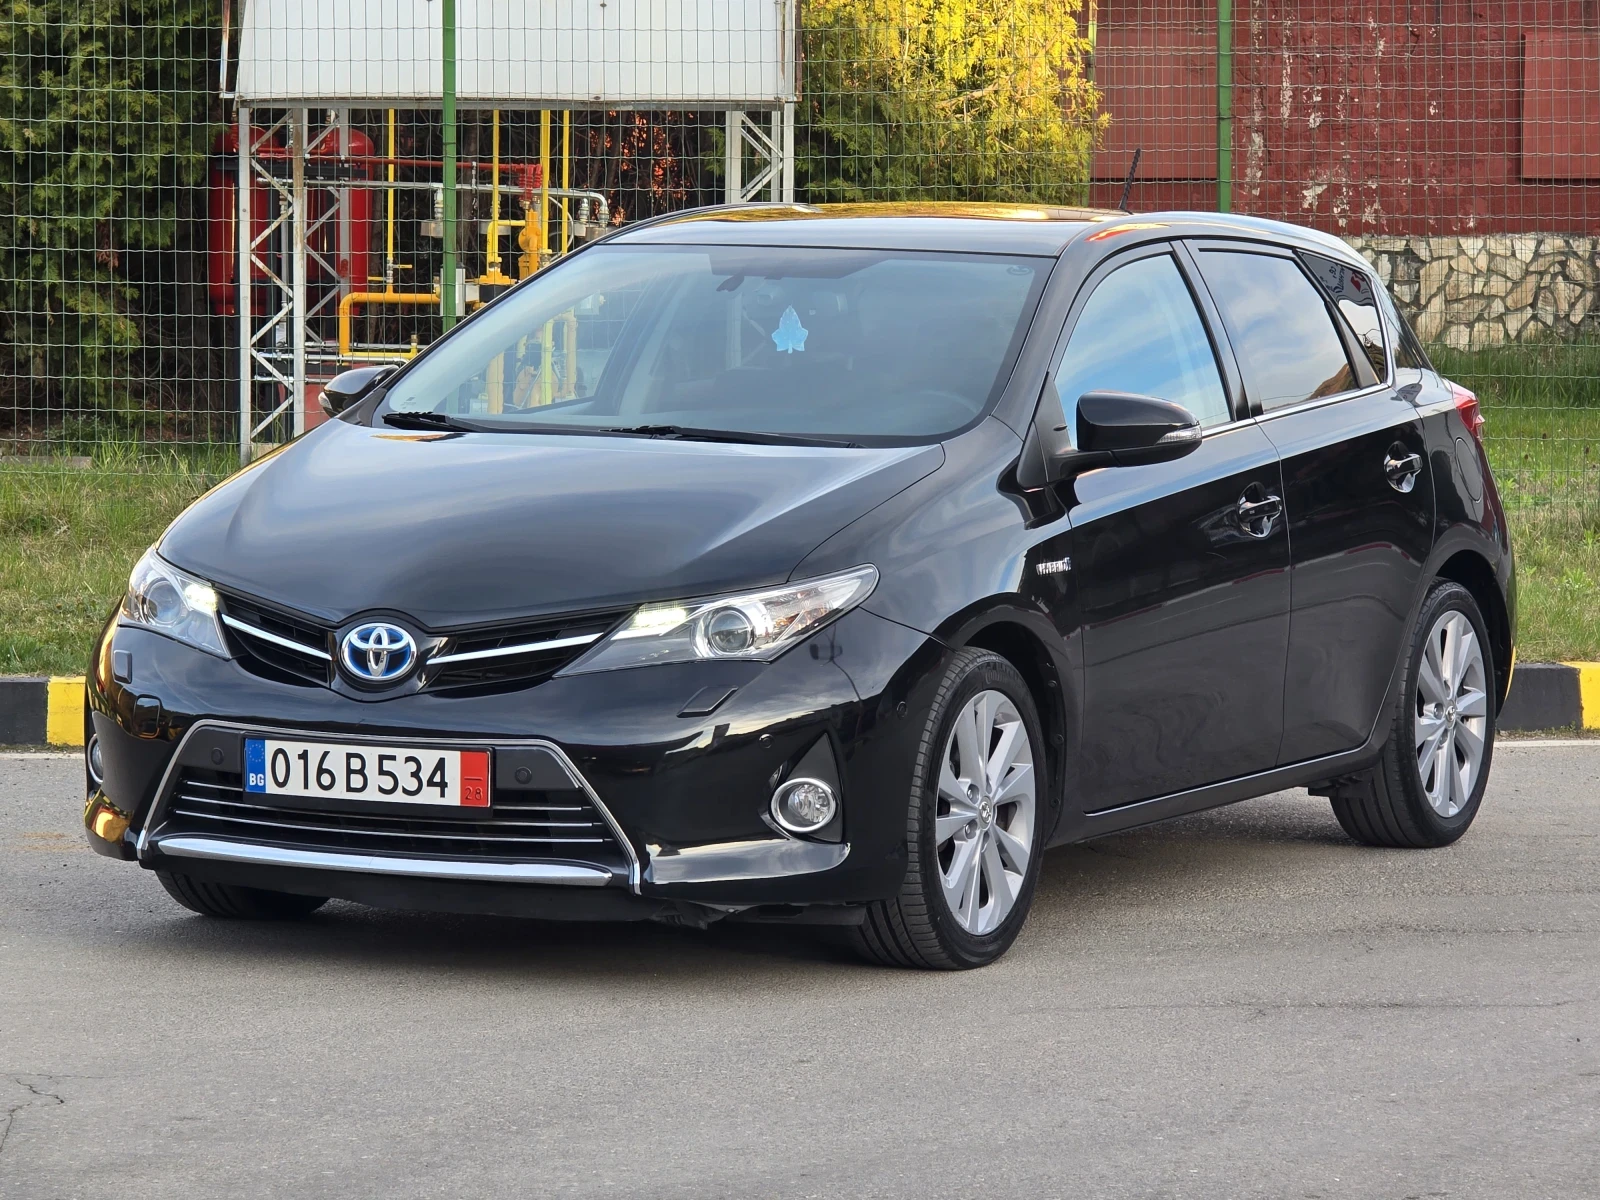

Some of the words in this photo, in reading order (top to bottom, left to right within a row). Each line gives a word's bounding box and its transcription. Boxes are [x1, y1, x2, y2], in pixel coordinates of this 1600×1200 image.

[249, 773, 265, 787] BG
[271, 747, 448, 798] 016B534
[464, 786, 483, 801] 28
